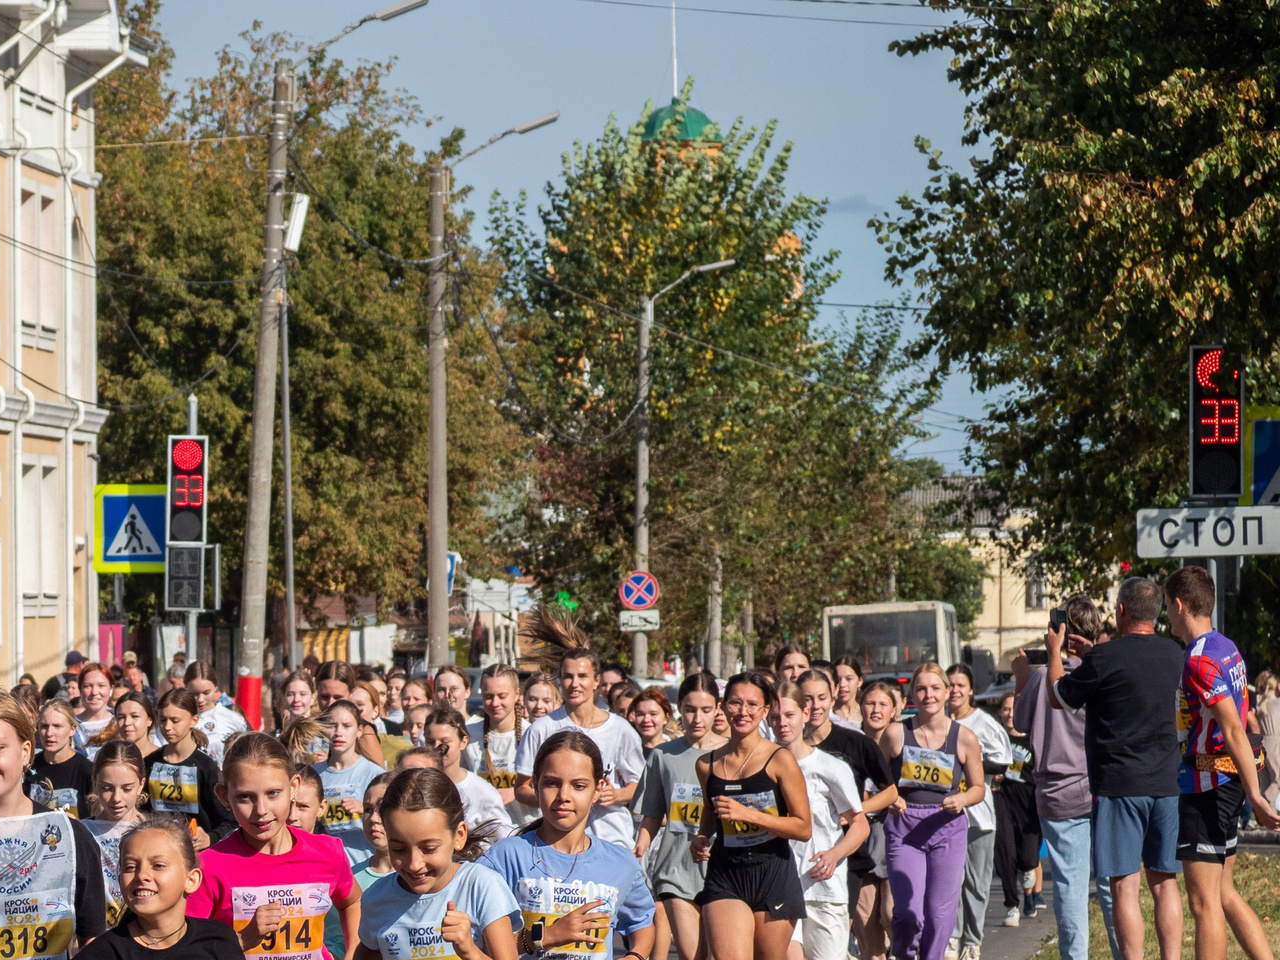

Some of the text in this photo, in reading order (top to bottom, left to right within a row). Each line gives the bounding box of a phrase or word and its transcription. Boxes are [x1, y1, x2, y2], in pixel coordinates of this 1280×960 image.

[1201, 400, 1239, 444] 33
[174, 474, 204, 507] 33
[1159, 515, 1264, 549] СТОП
[913, 765, 940, 783] 376
[159, 783, 184, 801] 723
[267, 889, 293, 897] КРОСС
[553, 887, 579, 895] КРОСС
[4, 898, 30, 907] КРОСС
[268, 897, 302, 906] НЦИИ
[553, 895, 587, 905] НАЦИИ
[4, 904, 38, 916] НАЦИИ
[6, 913, 41, 925] 2024
[408, 926, 434, 937] КРОСС
[0, 926, 48, 959] 318
[409, 935, 443, 947] НАЦИИ
[411, 945, 445, 958] 2024
